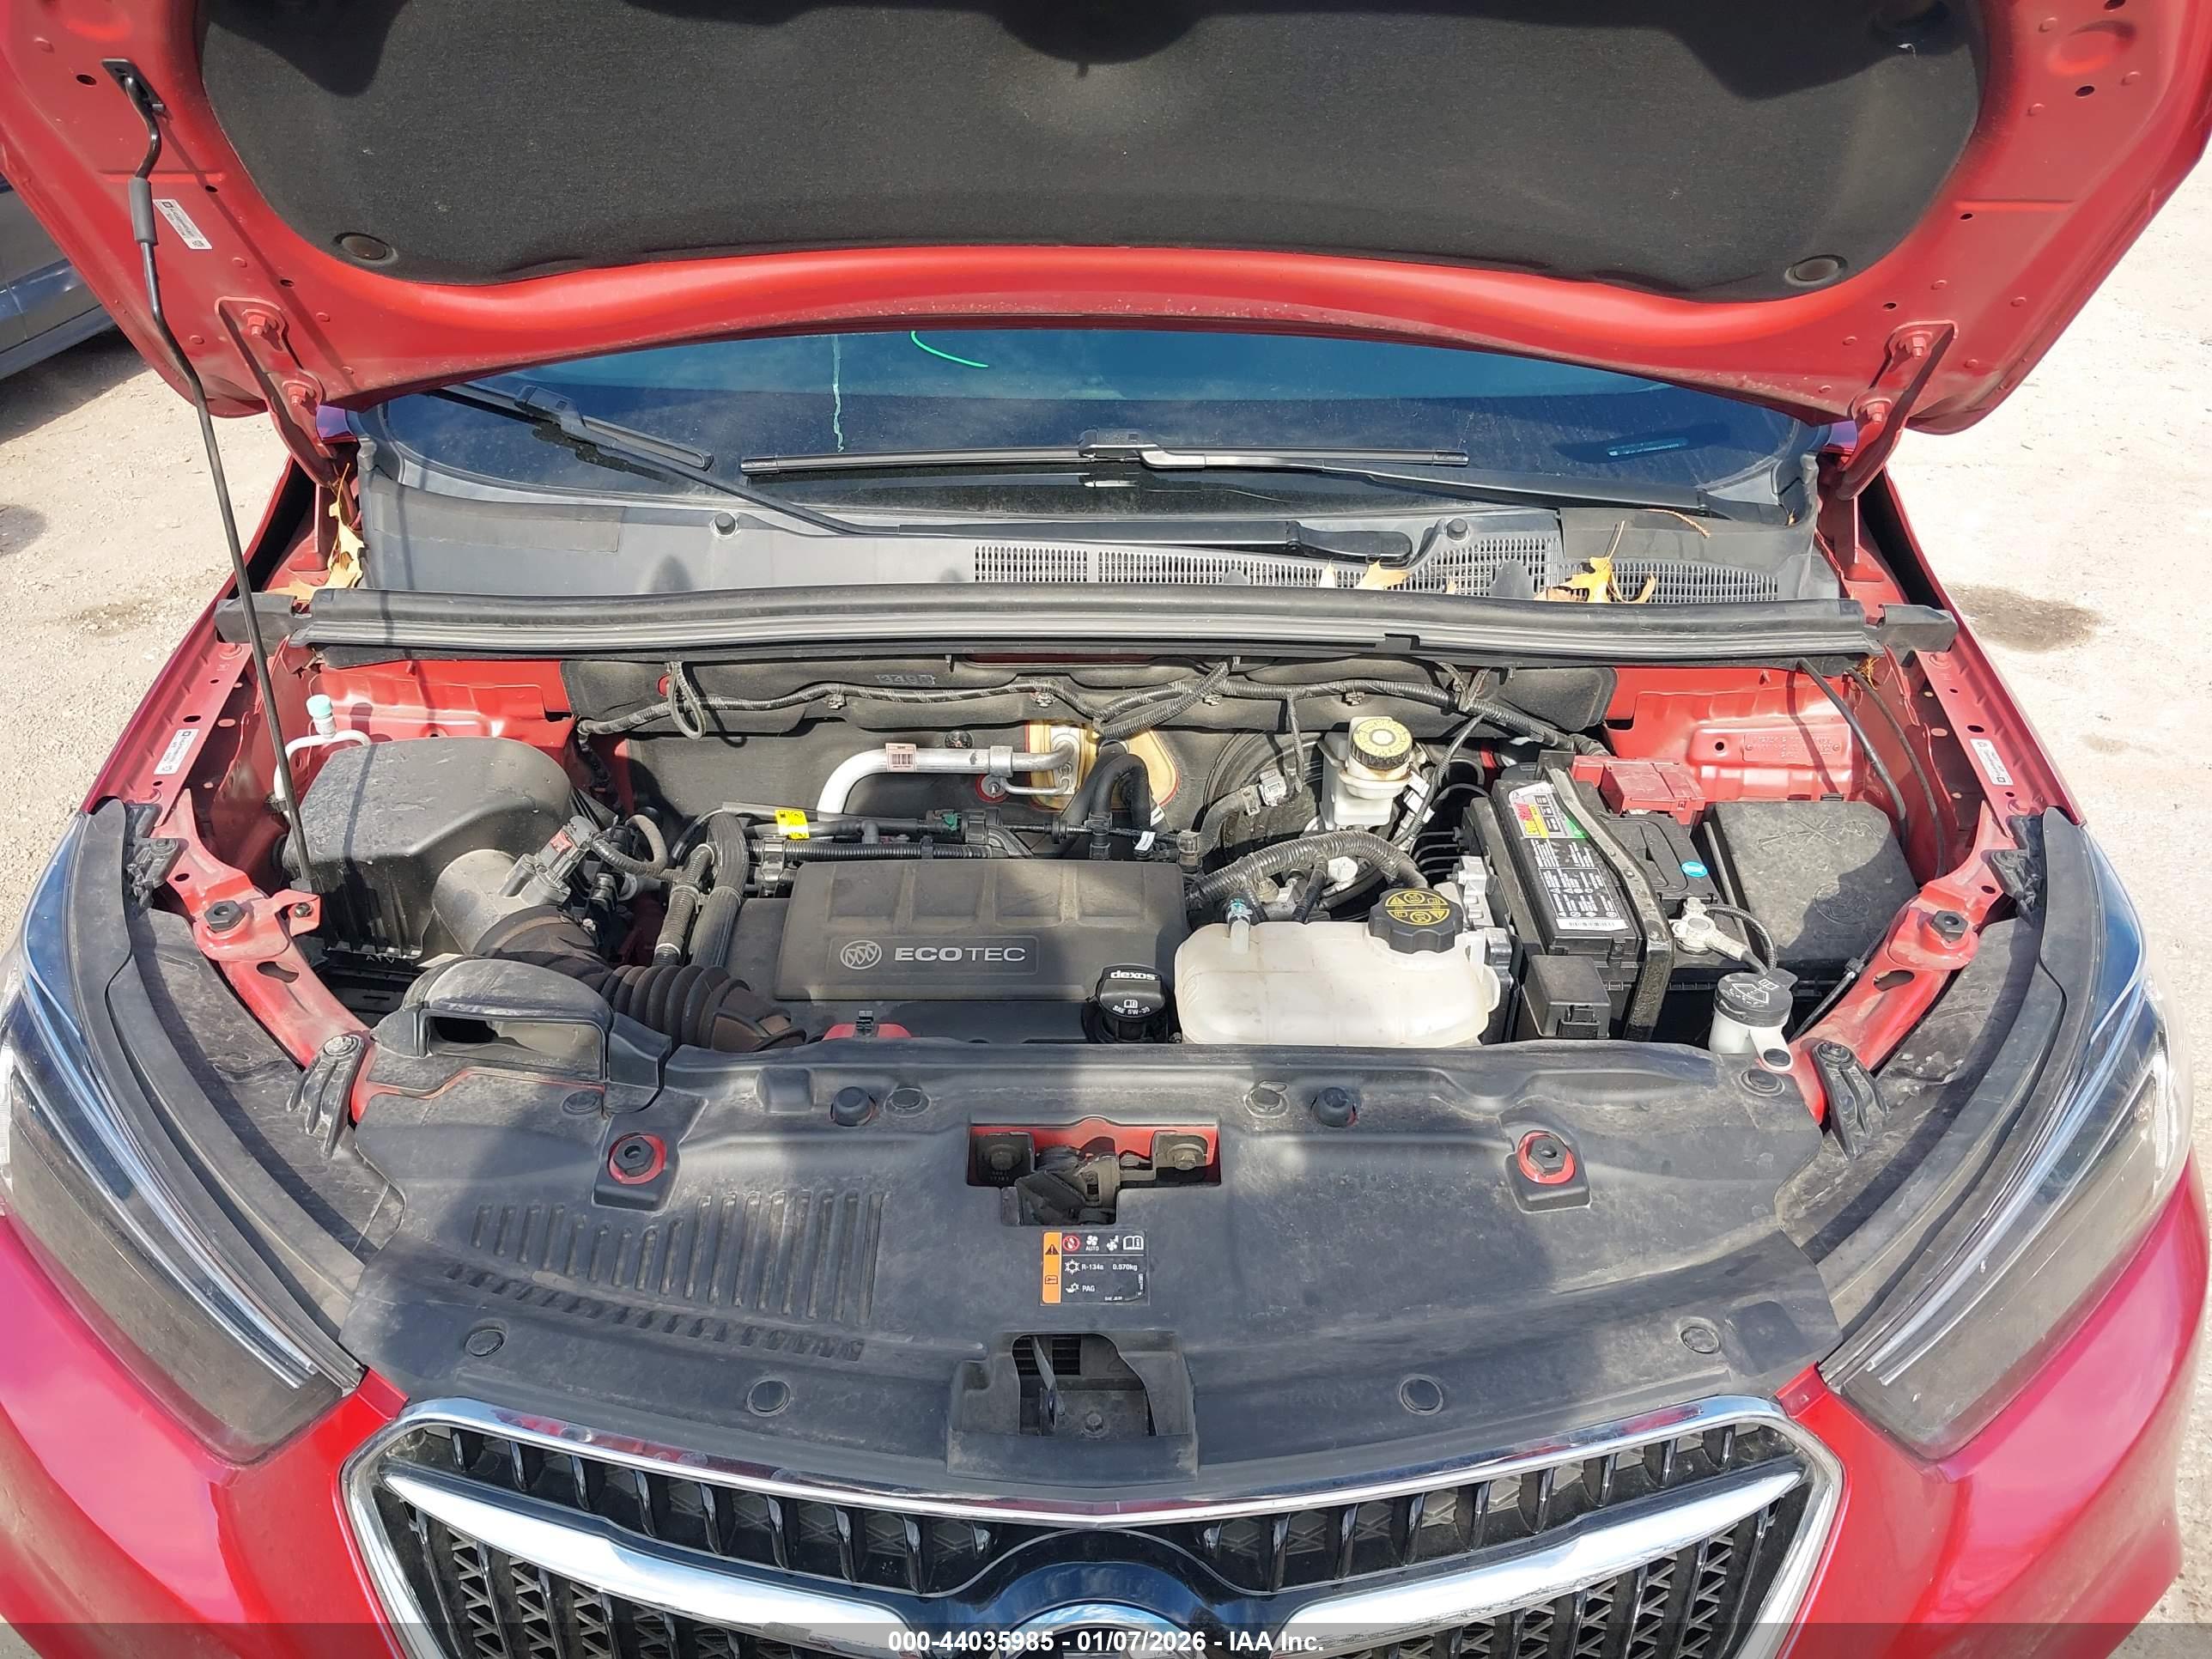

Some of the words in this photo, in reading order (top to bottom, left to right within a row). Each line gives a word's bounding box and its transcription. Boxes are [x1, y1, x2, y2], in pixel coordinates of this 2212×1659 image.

[894, 946, 1026, 962] ECOTEC
[1110, 969, 1156, 981] dexos
[1112, 1005, 1126, 1014] SAE
[1127, 1006, 1151, 1015] 5W-30
